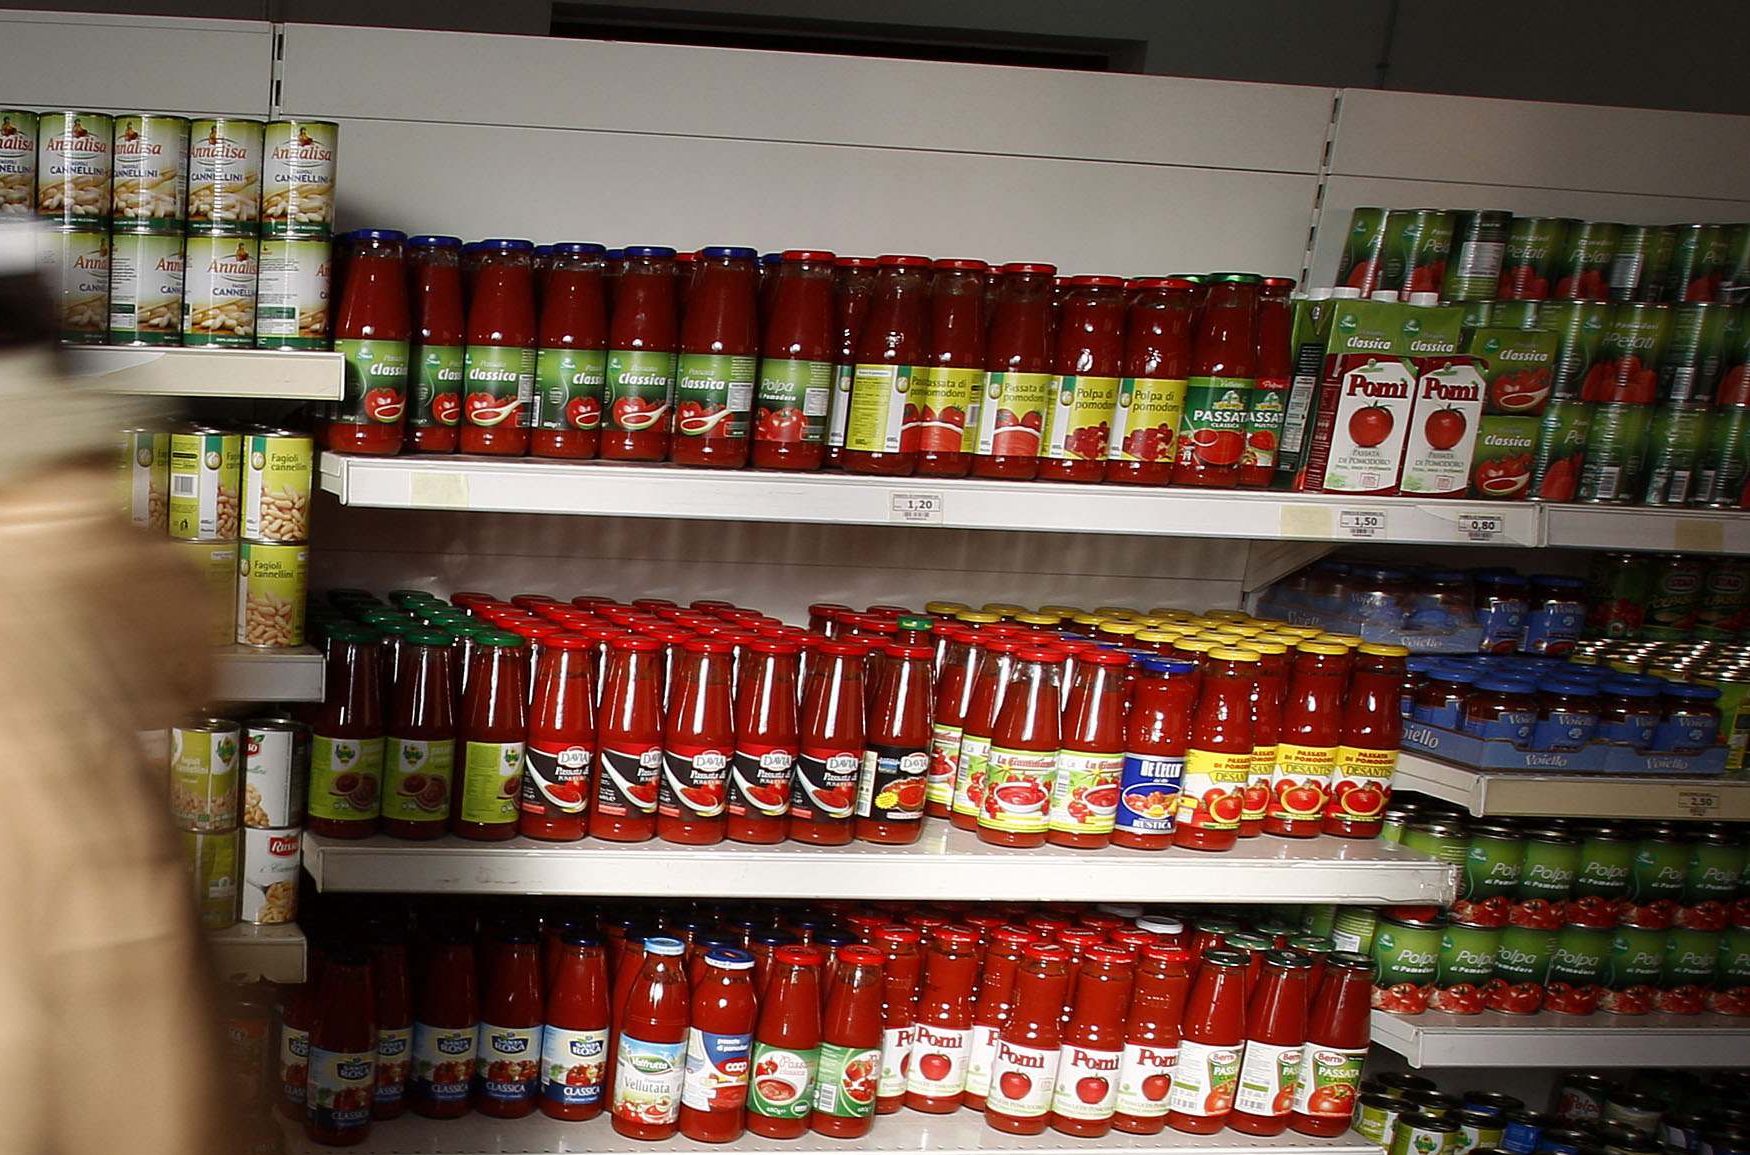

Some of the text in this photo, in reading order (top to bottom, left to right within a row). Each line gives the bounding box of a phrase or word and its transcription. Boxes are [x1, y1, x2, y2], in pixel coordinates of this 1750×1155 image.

[46, 138, 107, 153] Annalisa
[190, 145, 247, 160] Annalisa
[271, 146, 332, 161] Annalisa
[192, 173, 243, 181] CANNELLINI
[1347, 337, 1391, 350] Classica
[1411, 340, 1454, 353] Classica
[1602, 334, 1655, 350] Pelati
[1500, 350, 1547, 362] Classica
[470, 369, 516, 382] Classica
[619, 373, 666, 386] Classica
[681, 377, 725, 390] Classica
[761, 378, 795, 393] Polpa
[1004, 384, 1036, 393] Passata
[1076, 388, 1106, 400] Polpa
[1135, 390, 1174, 401] Polpa di
[1484, 435, 1531, 447] Classica
[271, 453, 299, 464] Fagioli
[1350, 457, 1390, 465] POMODORO
[1426, 459, 1464, 467] POMODORO
[908, 501, 932, 510] 1,20
[1354, 517, 1377, 527] 1,50
[254, 560, 282, 570] Fagioli
[254, 569, 294, 579] cannellini
[1400, 636, 1442, 649] Voiello
[560, 753, 589, 763] DAVIA
[696, 756, 725, 767] DAVIA
[763, 755, 791, 766] DAVIA
[829, 757, 858, 768] DAVIA
[903, 758, 928, 768] DAVIA
[1524, 753, 1567, 768] Voiello
[1345, 765, 1393, 776] DESANTIS
[1647, 758, 1688, 771] Voiello
[1133, 820, 1172, 830] RUSTICA
[1530, 864, 1573, 882] Polpa
[1585, 862, 1628, 879] Polpa
[1554, 949, 1599, 968] Polpa
[632, 1057, 670, 1069] Valfrutta
[1318, 1067, 1360, 1078] PASSATA
[432, 1082, 469, 1094] CLASSICA
[486, 1082, 526, 1093] CLASSICA
[563, 1085, 601, 1095] CLASSICA
[624, 1076, 670, 1093] Vellutata
